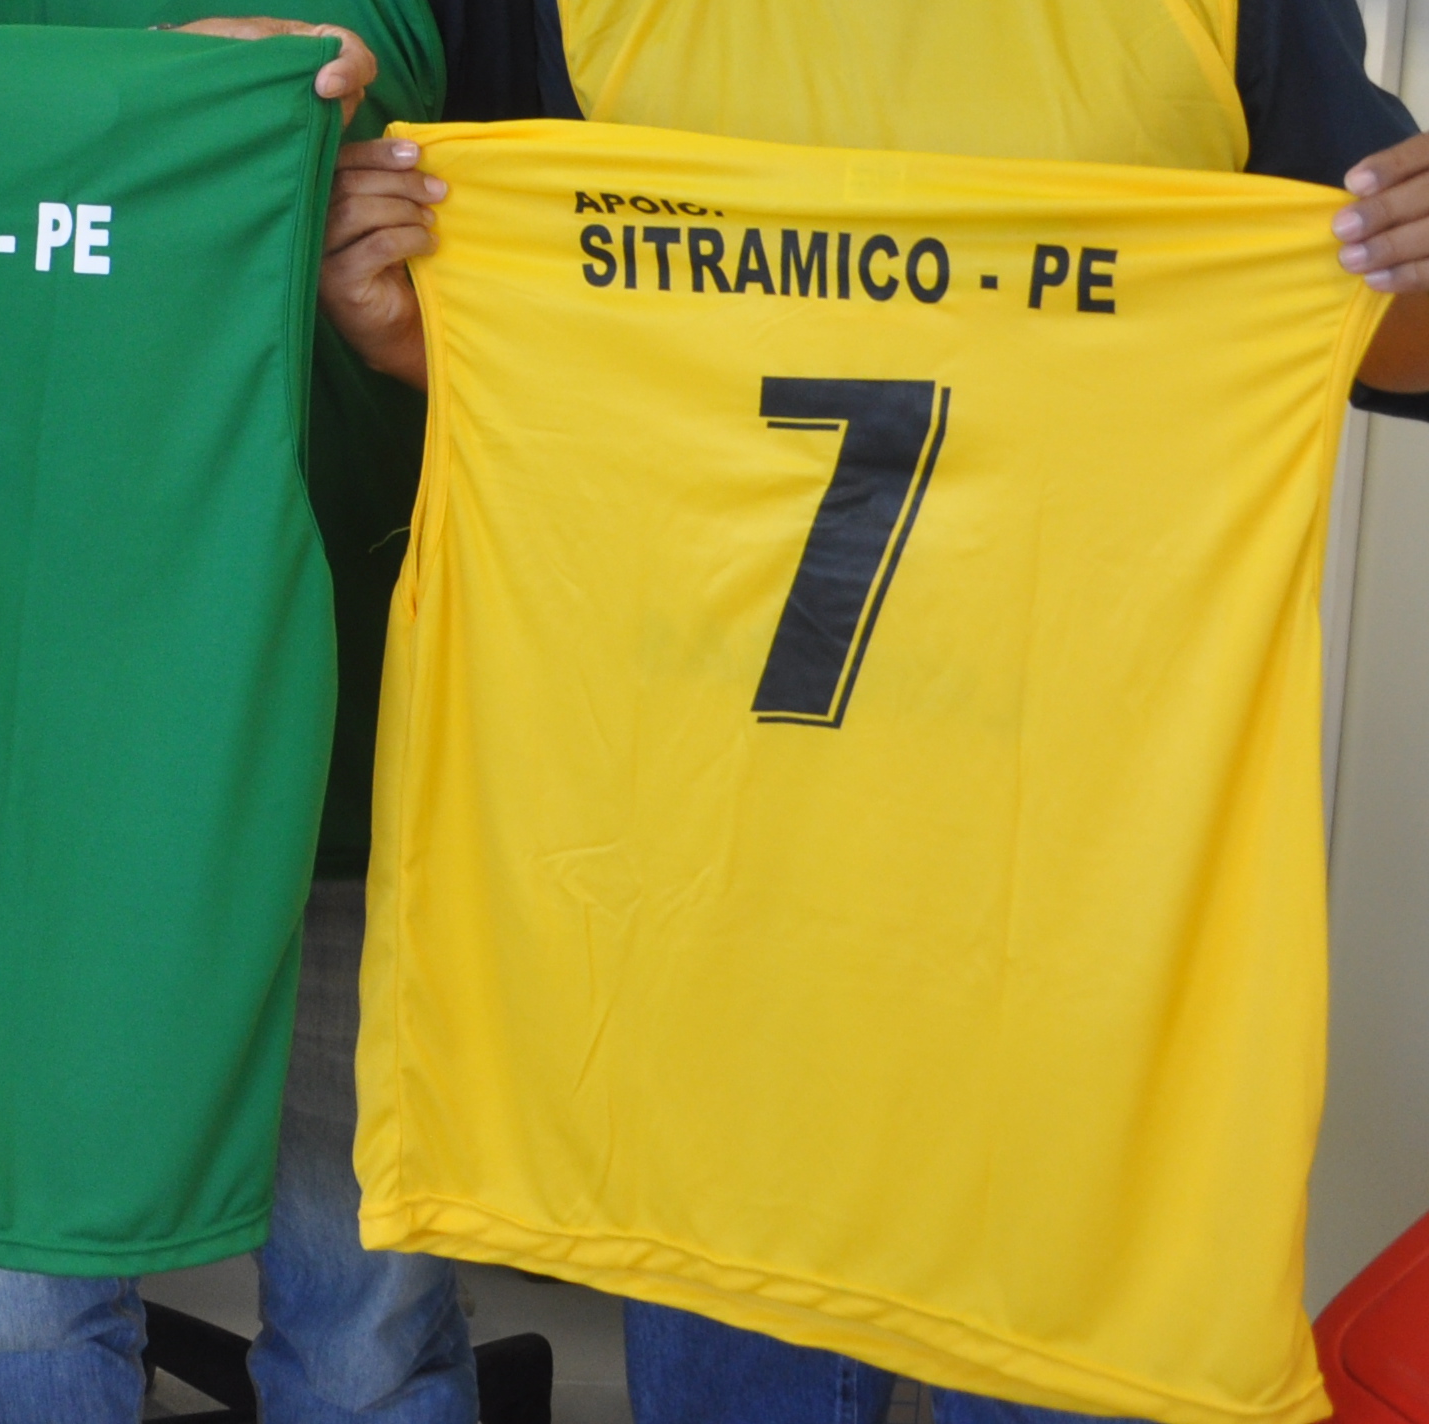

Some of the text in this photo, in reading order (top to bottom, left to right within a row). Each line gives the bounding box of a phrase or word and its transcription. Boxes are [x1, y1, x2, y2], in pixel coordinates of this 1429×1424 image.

[35, 202, 112, 275] PE
[579, 224, 1118, 315] SITRAMICO - PE
[750, 376, 951, 730] 7
